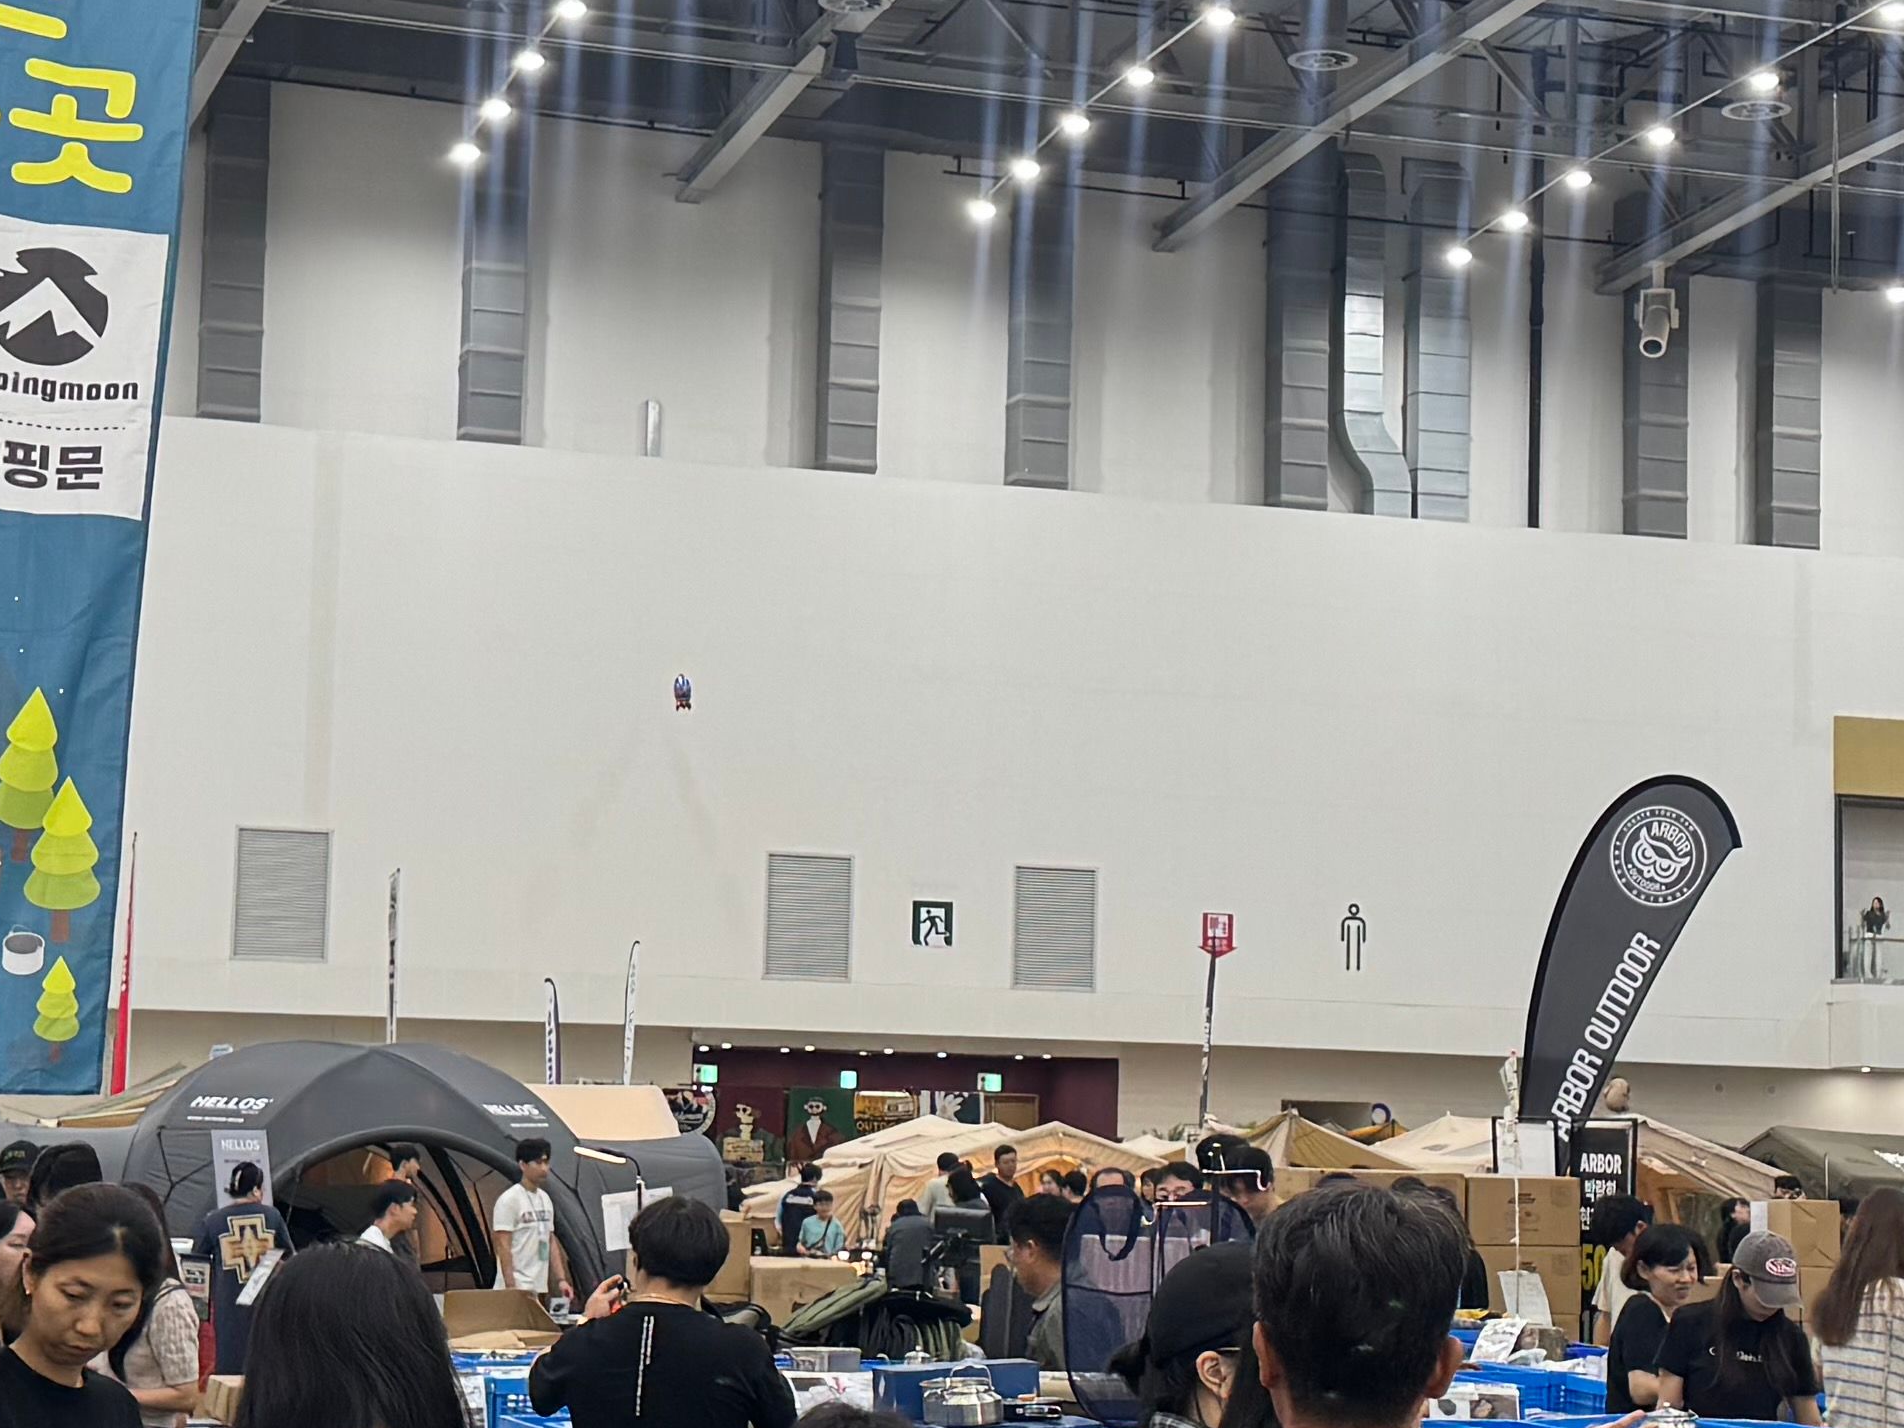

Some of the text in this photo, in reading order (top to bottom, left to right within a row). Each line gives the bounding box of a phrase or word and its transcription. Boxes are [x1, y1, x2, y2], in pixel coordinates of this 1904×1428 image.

[1650, 821, 1691, 856] ARBOR
[1546, 1047, 1603, 1145] ARBOR
[1584, 931, 1662, 1050] OUTDOOR
[1580, 1152, 1622, 1175] ARBOR
